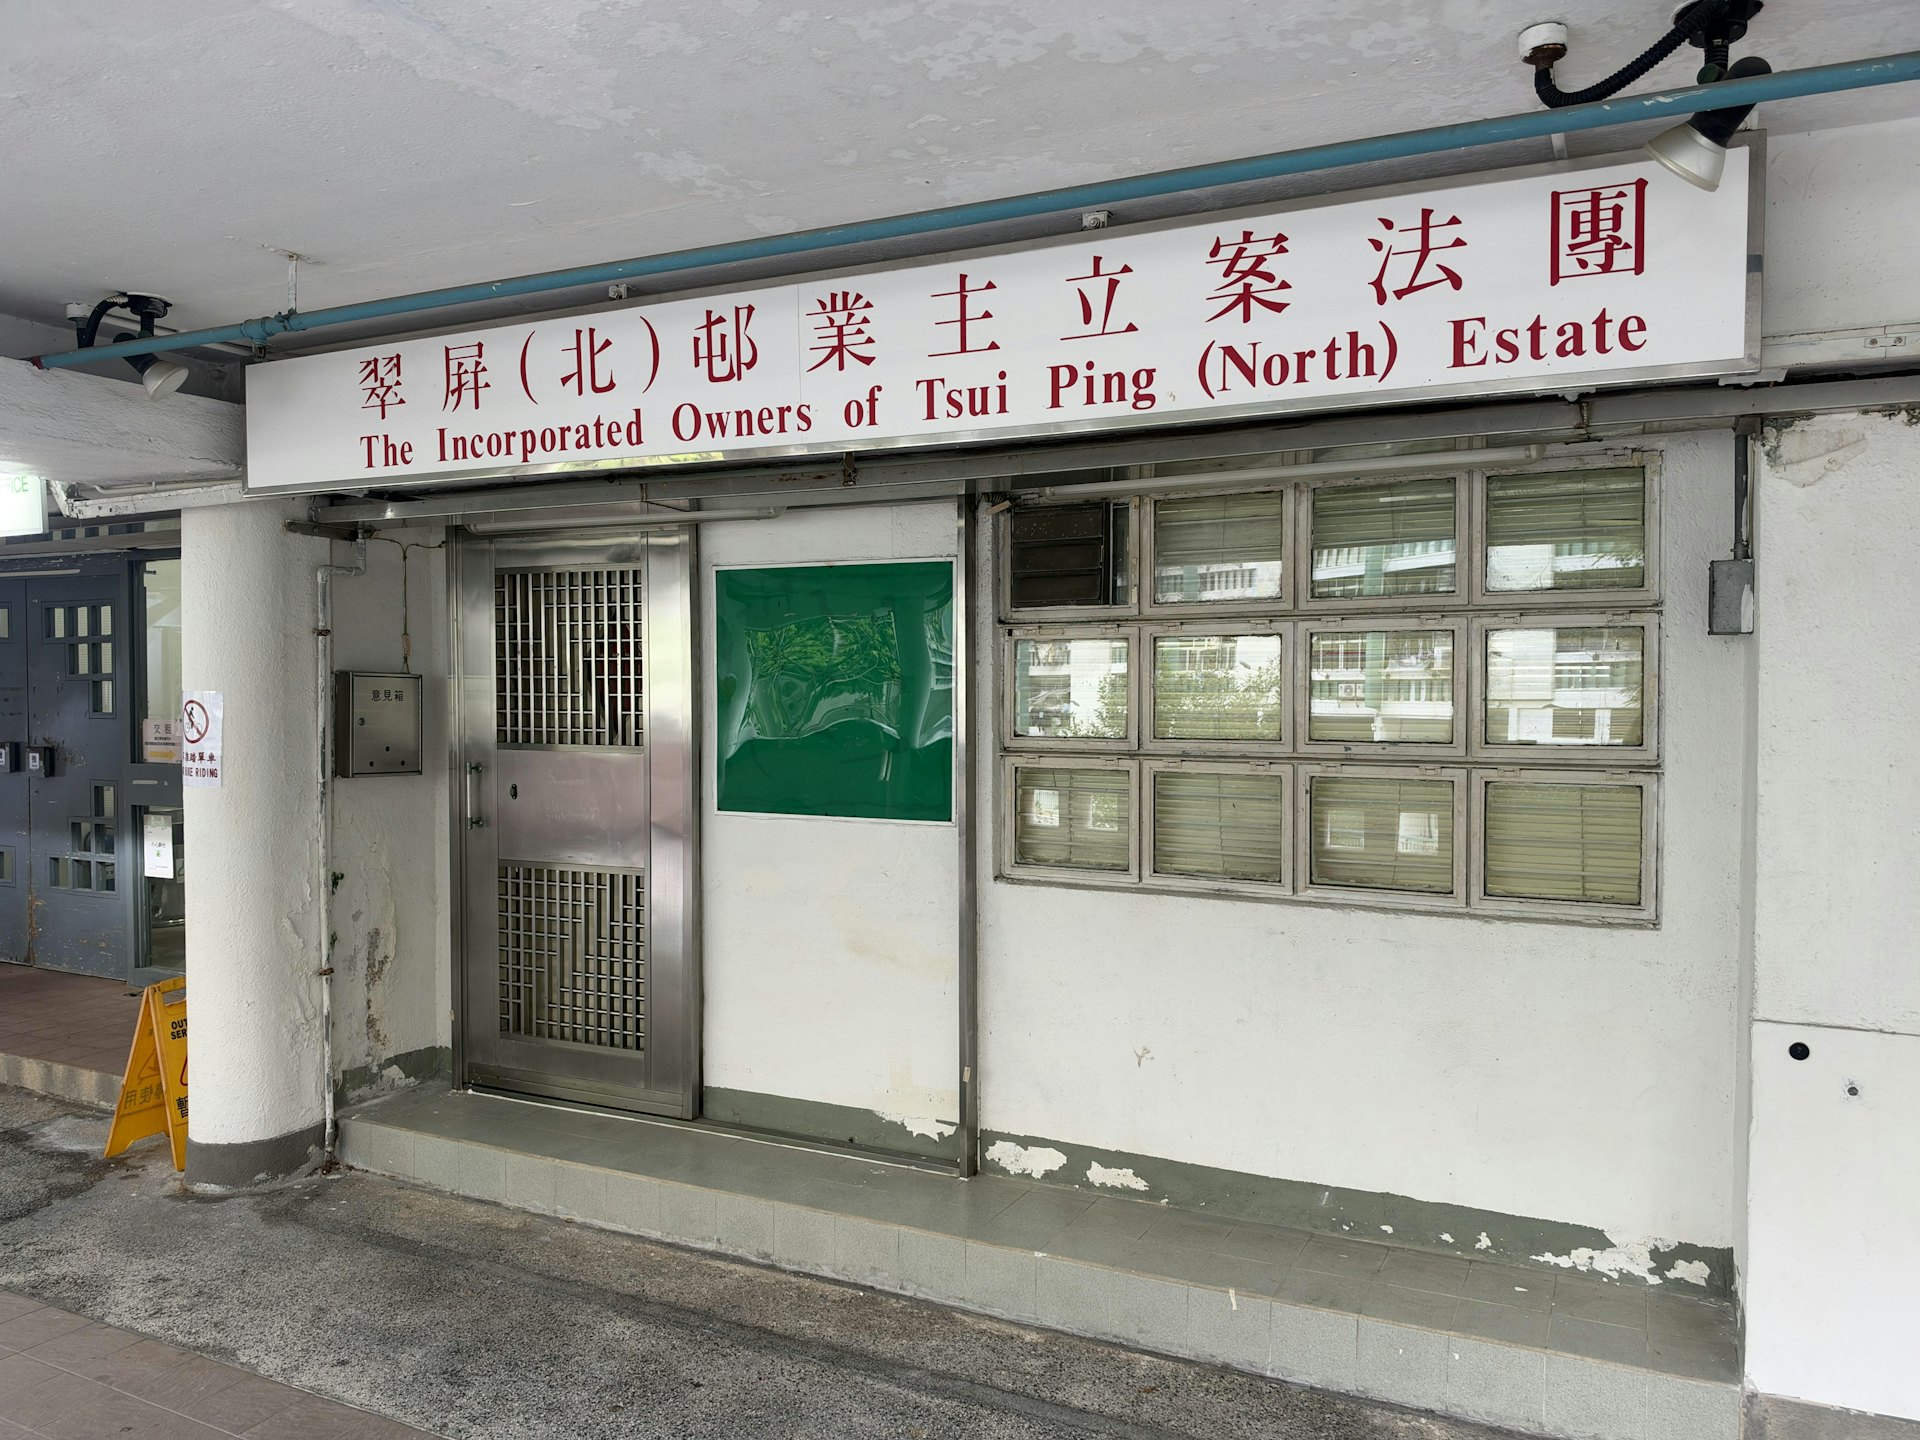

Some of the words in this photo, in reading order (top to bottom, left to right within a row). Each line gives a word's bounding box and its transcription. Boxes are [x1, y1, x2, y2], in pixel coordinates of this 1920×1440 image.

[360, 434, 413, 469] The
[438, 405, 643, 464] Incorporated
[671, 402, 812, 441] Owners
[844, 385, 882, 428] of
[915, 371, 1010, 421] Tsui
[1046, 361, 1157, 411] Ping
[1198, 321, 1398, 400] (North)
[1447, 307, 1647, 369] Estate
[371, 689, 404, 702] 意見箱
[195, 767, 218, 778] RIDING
